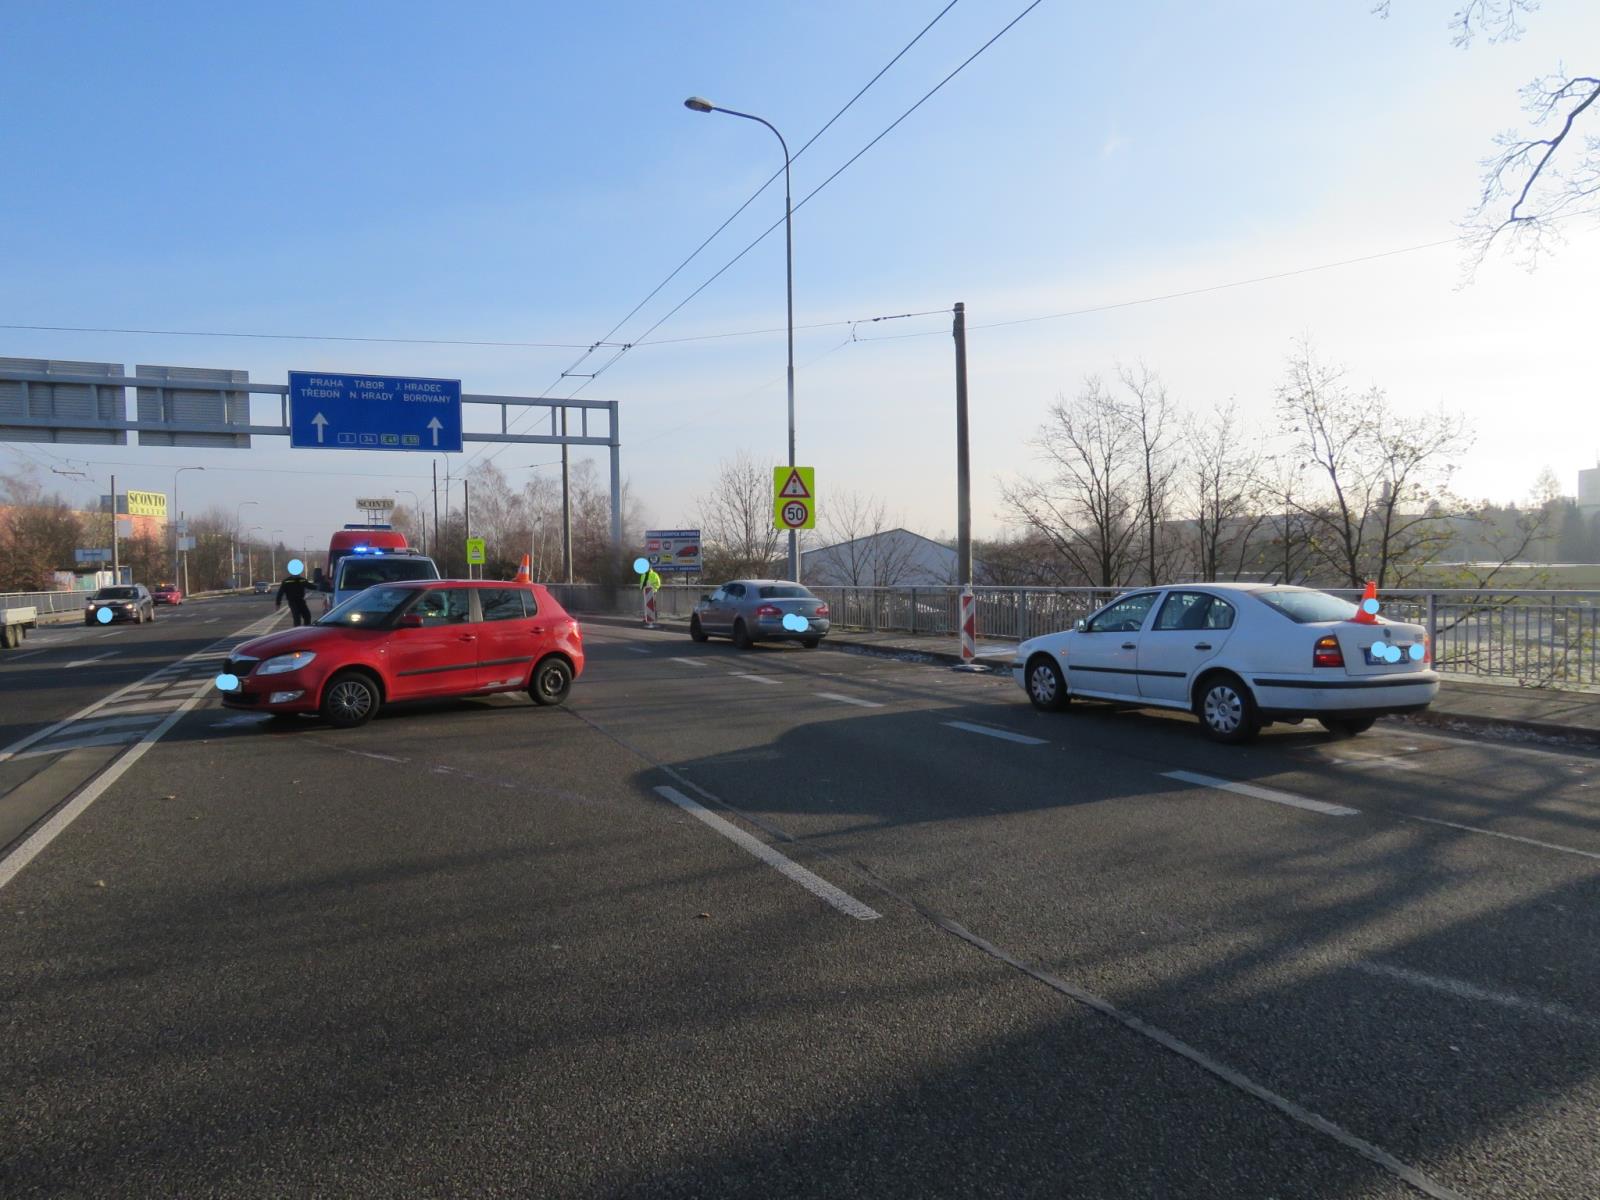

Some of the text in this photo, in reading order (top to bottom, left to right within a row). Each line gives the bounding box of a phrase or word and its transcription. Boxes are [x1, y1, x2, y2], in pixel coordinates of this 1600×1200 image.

[310, 378, 344, 388] PRAHA
[404, 383, 442, 392] HRADEC
[361, 391, 394, 400] HRADY
[403, 393, 451, 404] BOROVANY
[129, 492, 165, 507] SCONTO
[787, 507, 803, 521] 50
